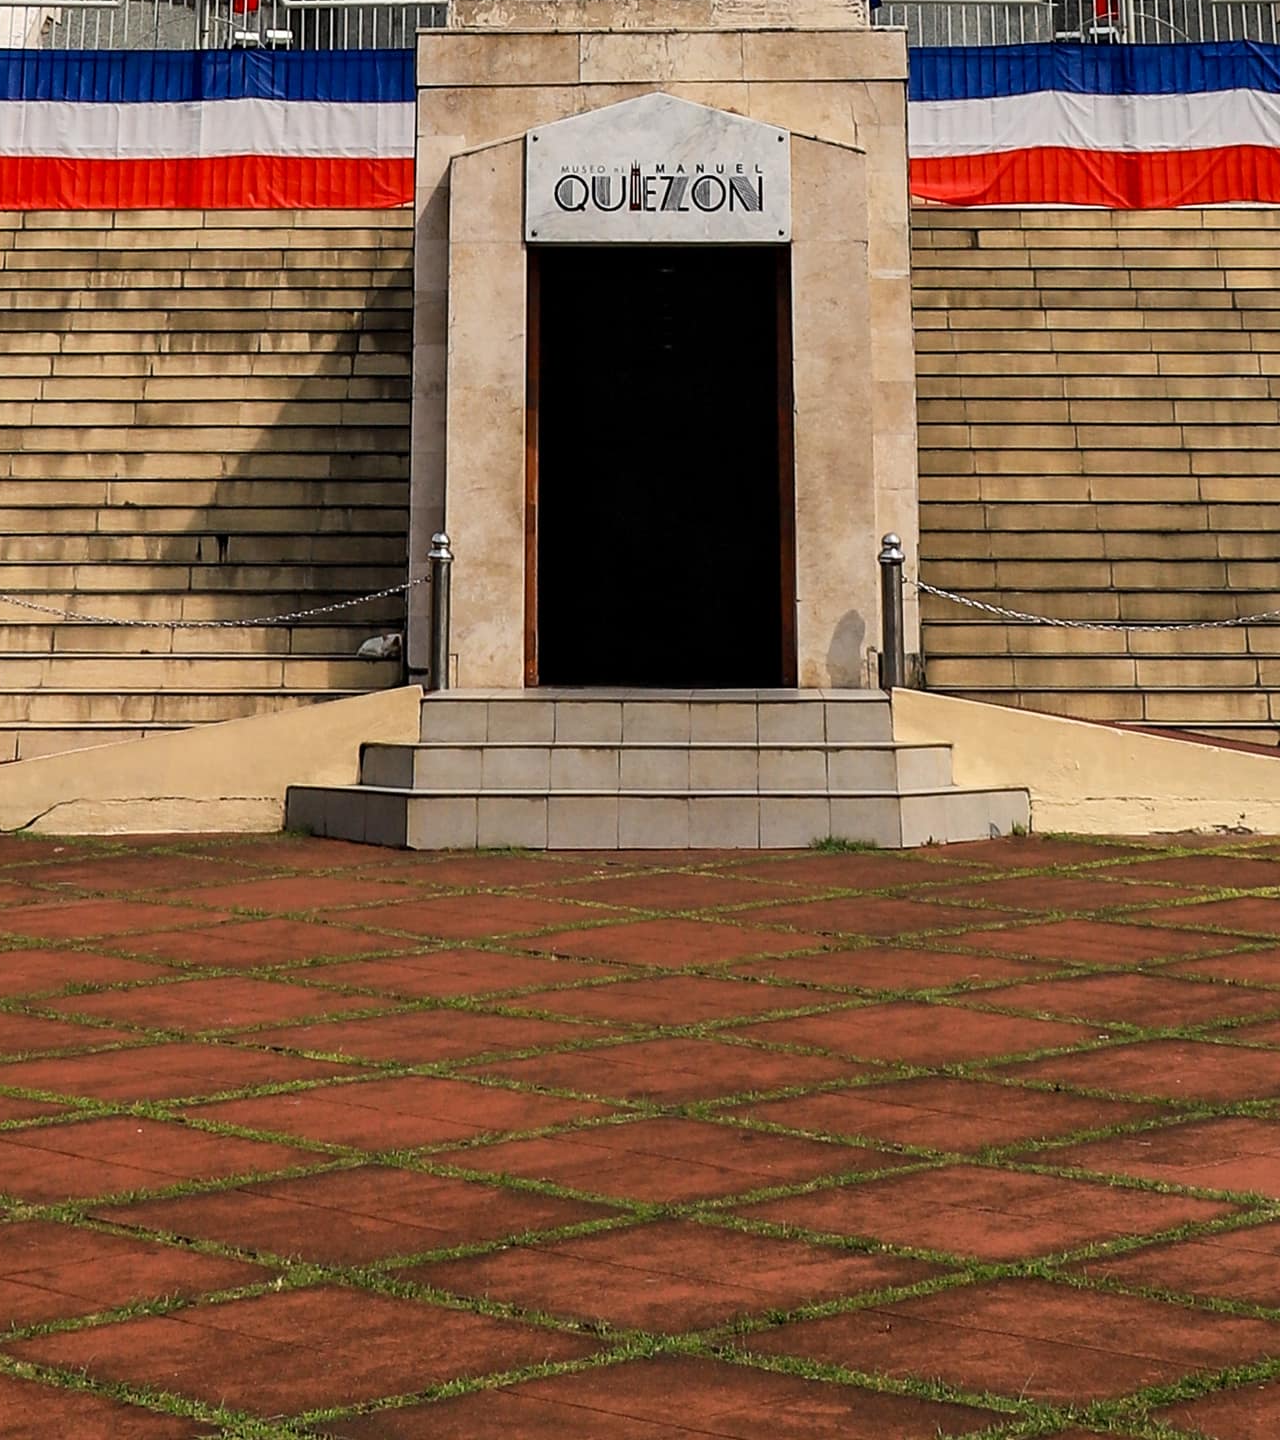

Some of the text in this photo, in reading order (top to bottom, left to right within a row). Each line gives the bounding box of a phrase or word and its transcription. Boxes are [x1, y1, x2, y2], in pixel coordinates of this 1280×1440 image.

[561, 165, 606, 174] MUSEO
[655, 164, 763, 174] MANUEL
[554, 174, 763, 212] QUEZON
